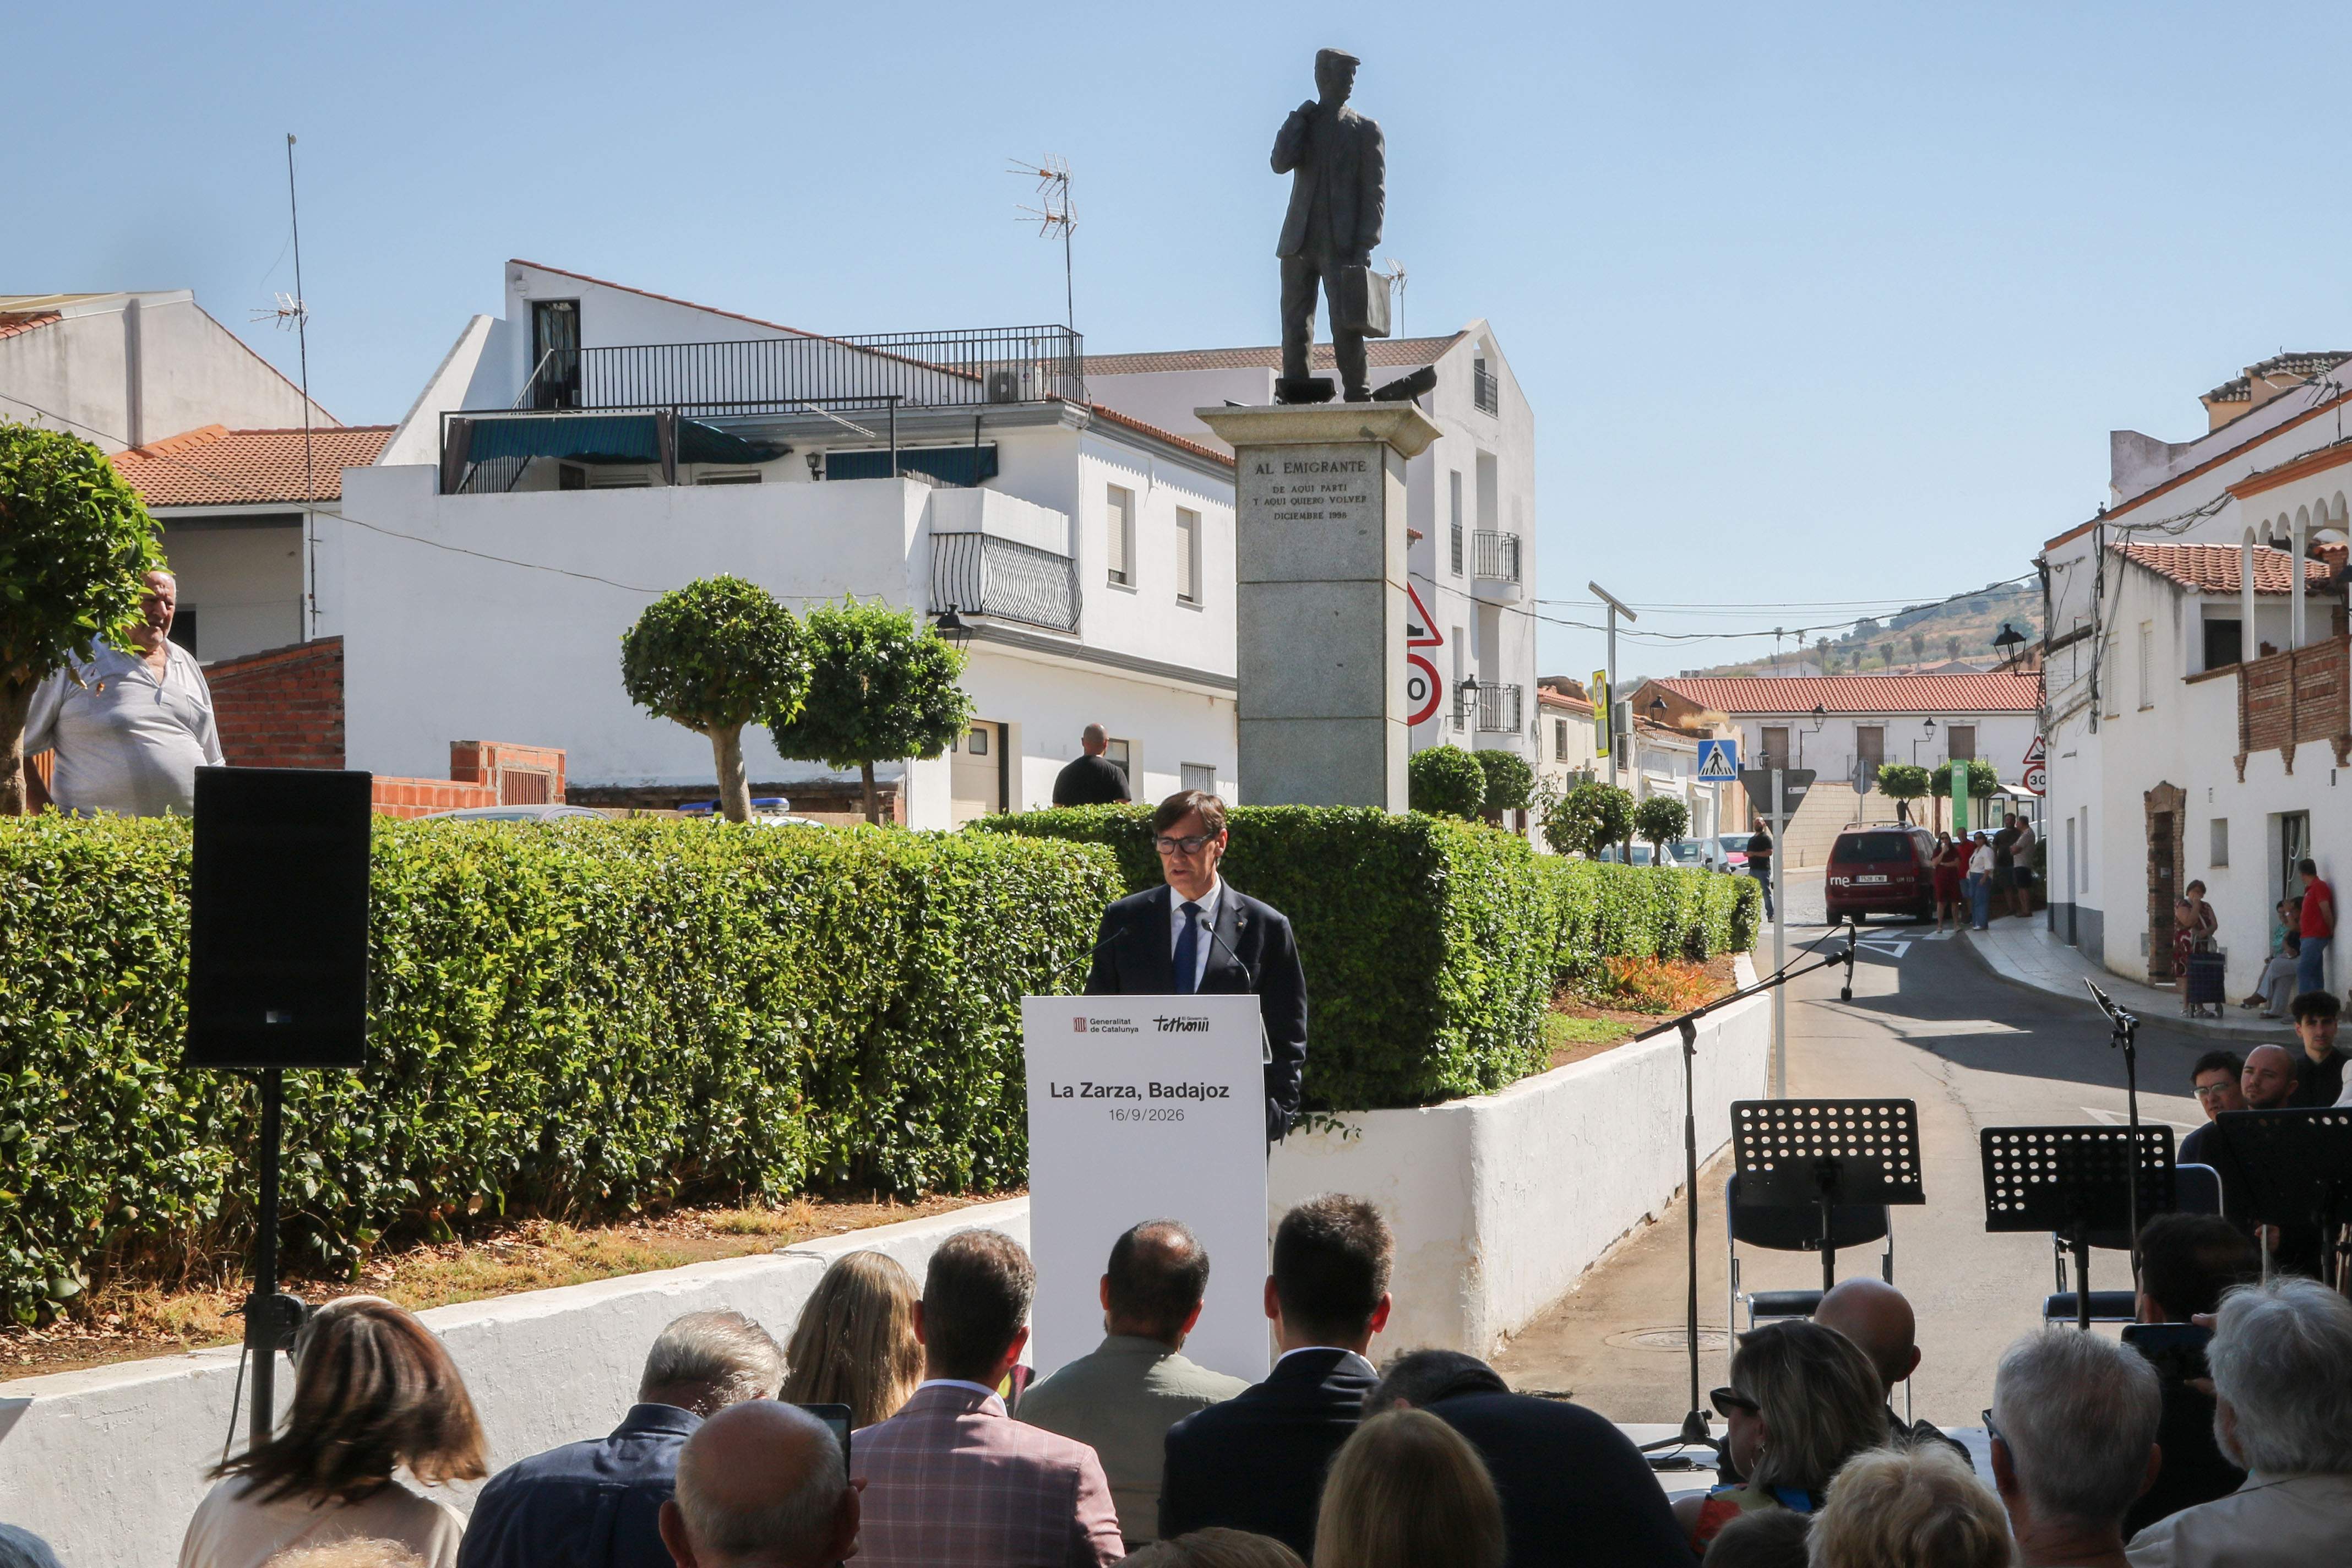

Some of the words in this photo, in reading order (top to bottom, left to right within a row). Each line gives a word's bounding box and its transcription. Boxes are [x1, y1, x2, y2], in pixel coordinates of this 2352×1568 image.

[1255, 463, 1274, 475] AL
[1283, 461, 1366, 473] EMIGRANTE
[1291, 485, 1314, 493] AQUI
[1321, 484, 1347, 492] PARTI
[1264, 498, 1286, 506] AQUI
[1291, 497, 1324, 505] QUIERO
[1330, 496, 1366, 504] VOLVER
[1274, 512, 1323, 520] DICIEMBRE
[1407, 677, 1426, 701] 0
[2030, 775, 2046, 785] 30
[1830, 876, 1850, 887] rne
[1102, 1026, 1139, 1034] Catalunya
[1050, 1082, 1074, 1098] La
[1080, 1082, 1142, 1101] Zarza,
[1148, 1081, 1230, 1101] Badajoz
[1108, 1108, 1185, 1121] 16/9/2026
